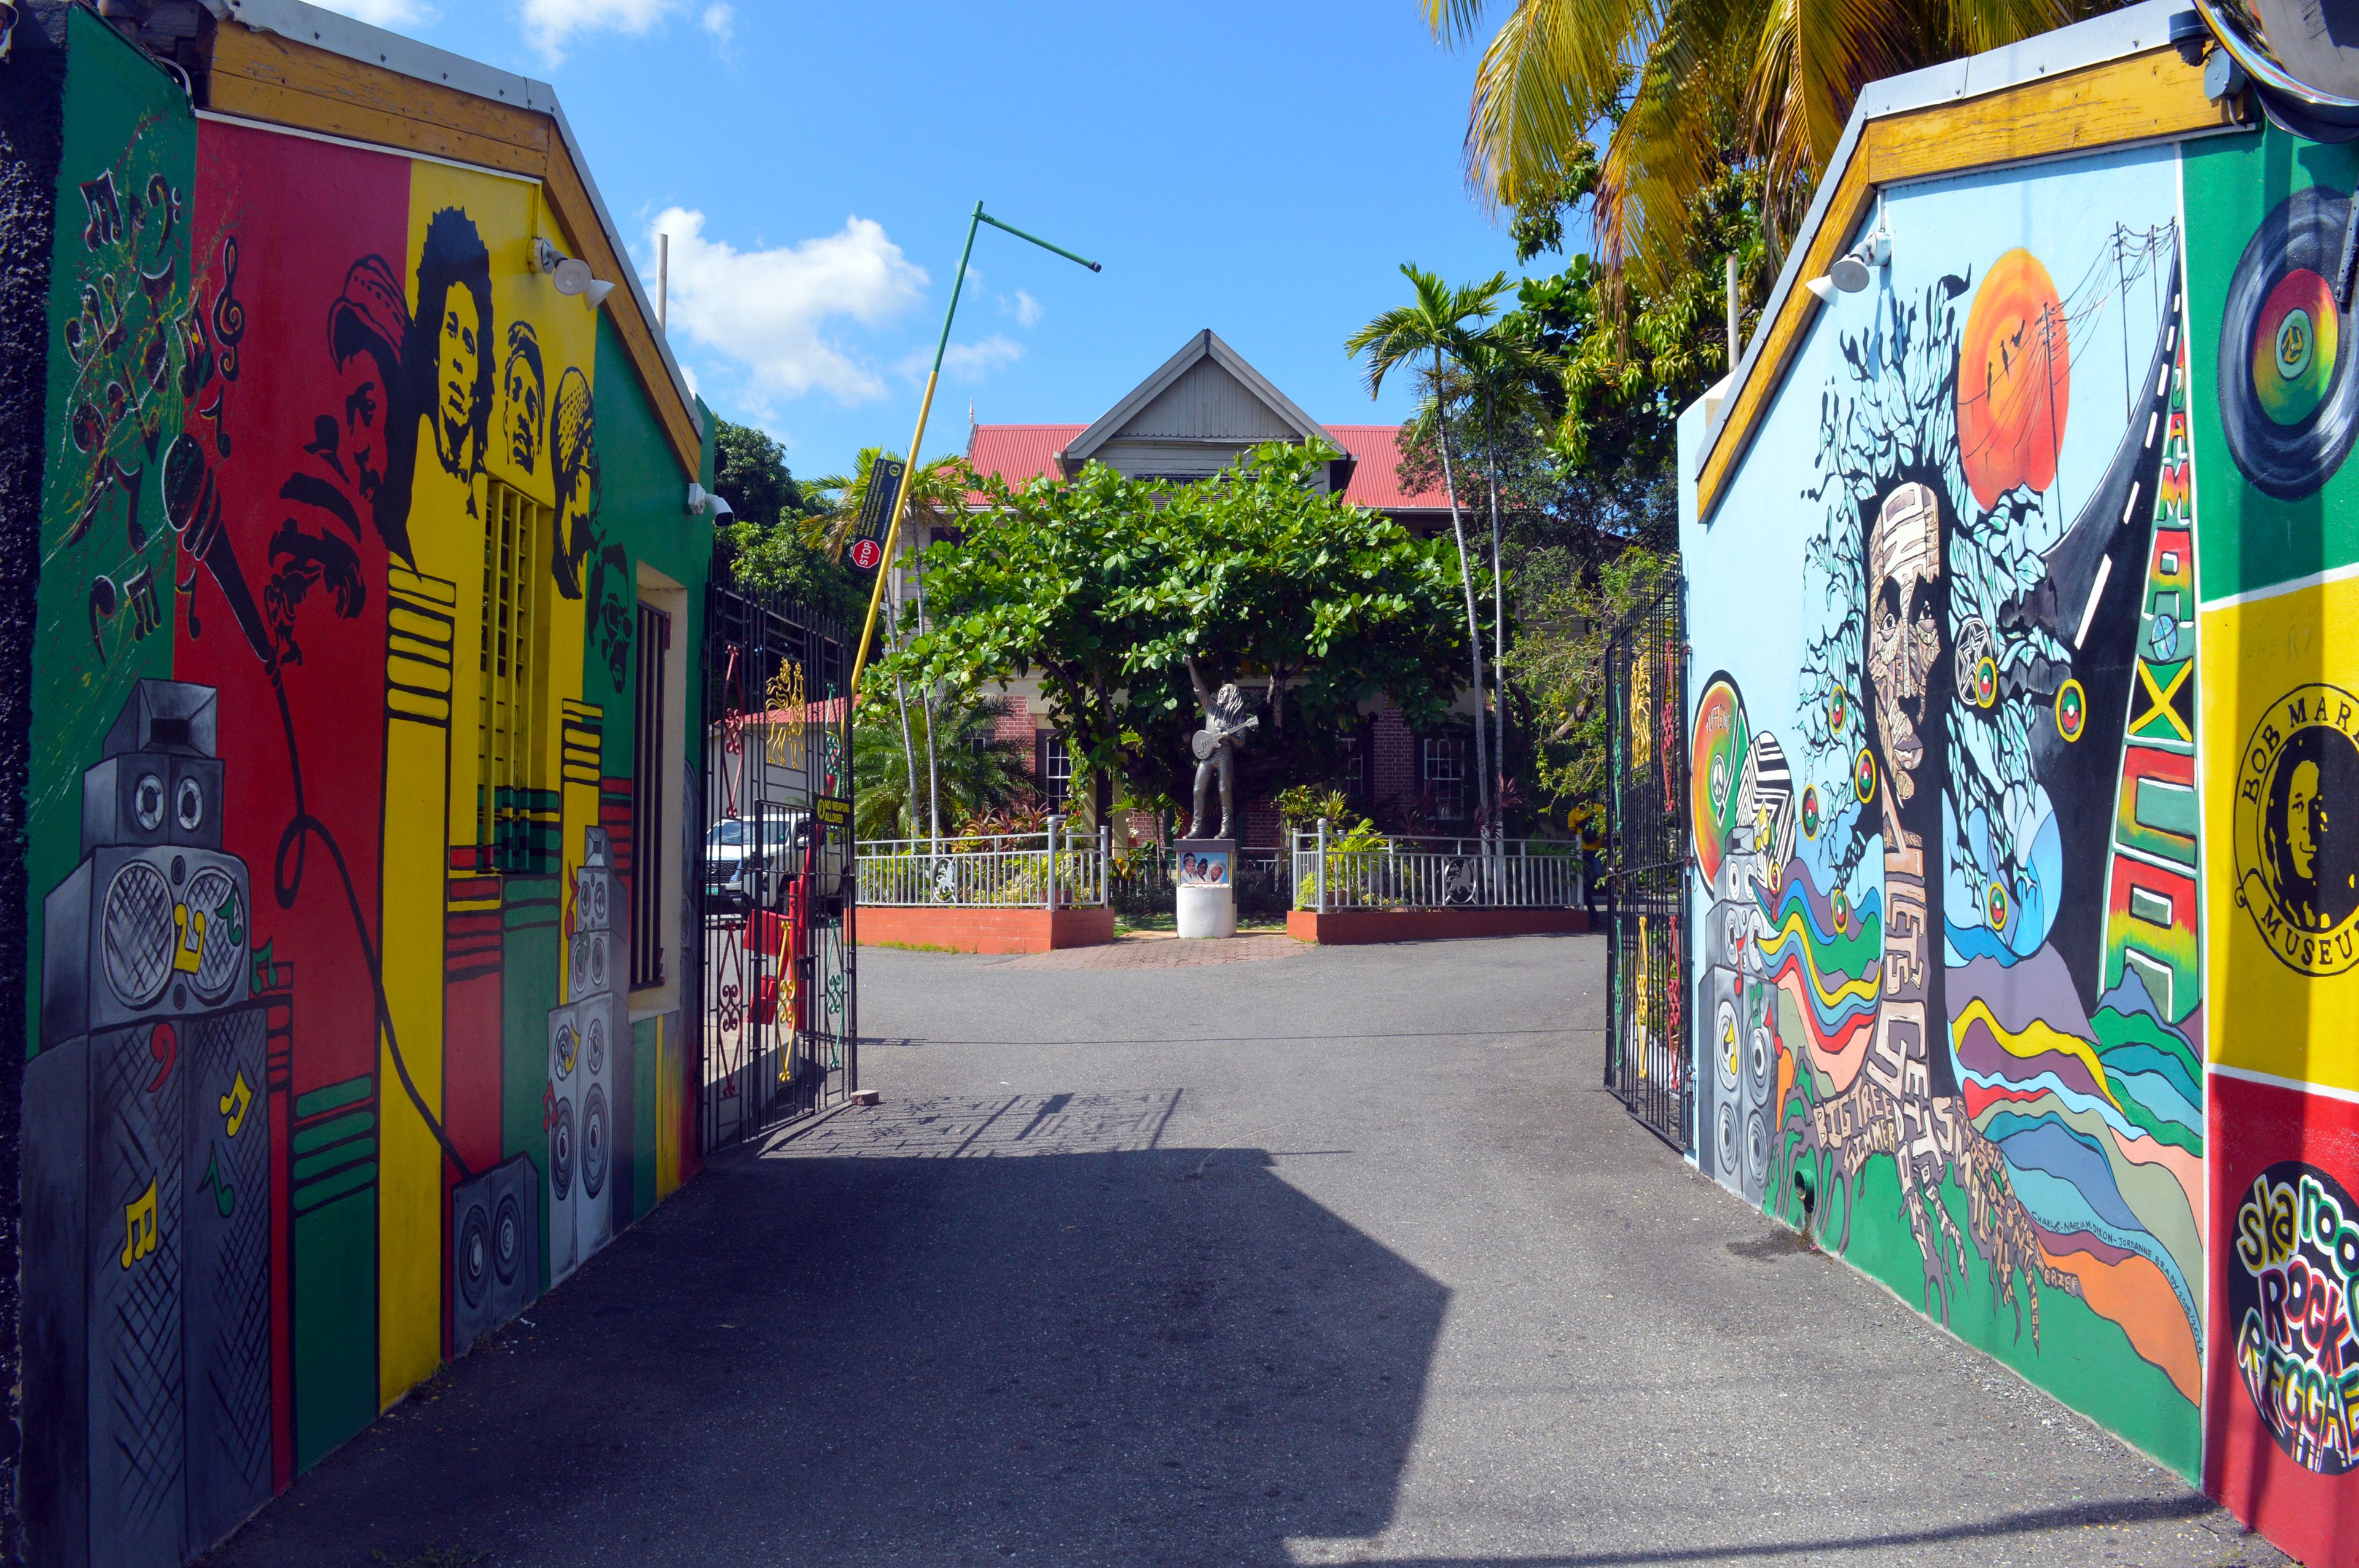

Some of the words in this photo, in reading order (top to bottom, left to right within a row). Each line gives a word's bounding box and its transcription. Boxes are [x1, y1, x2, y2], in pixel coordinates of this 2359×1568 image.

[871, 468, 880, 487] packages
[875, 474, 884, 492] entering
[877, 492, 885, 512] premises.
[859, 542, 874, 566] STOP
[2242, 724, 2280, 806] BOB
[824, 800, 831, 810] NO
[832, 801, 850, 814] WEAPONS
[824, 812, 843, 824] ALLOWED
[1813, 1093, 1852, 1148] BIG
[1850, 1075, 1893, 1129] TREE
[1844, 1119, 1896, 1178] SIMMER
[2237, 1174, 2299, 1277] ska
[2155, 1256, 2180, 1291] BRADY
[2258, 1260, 2349, 1377] ROCK
